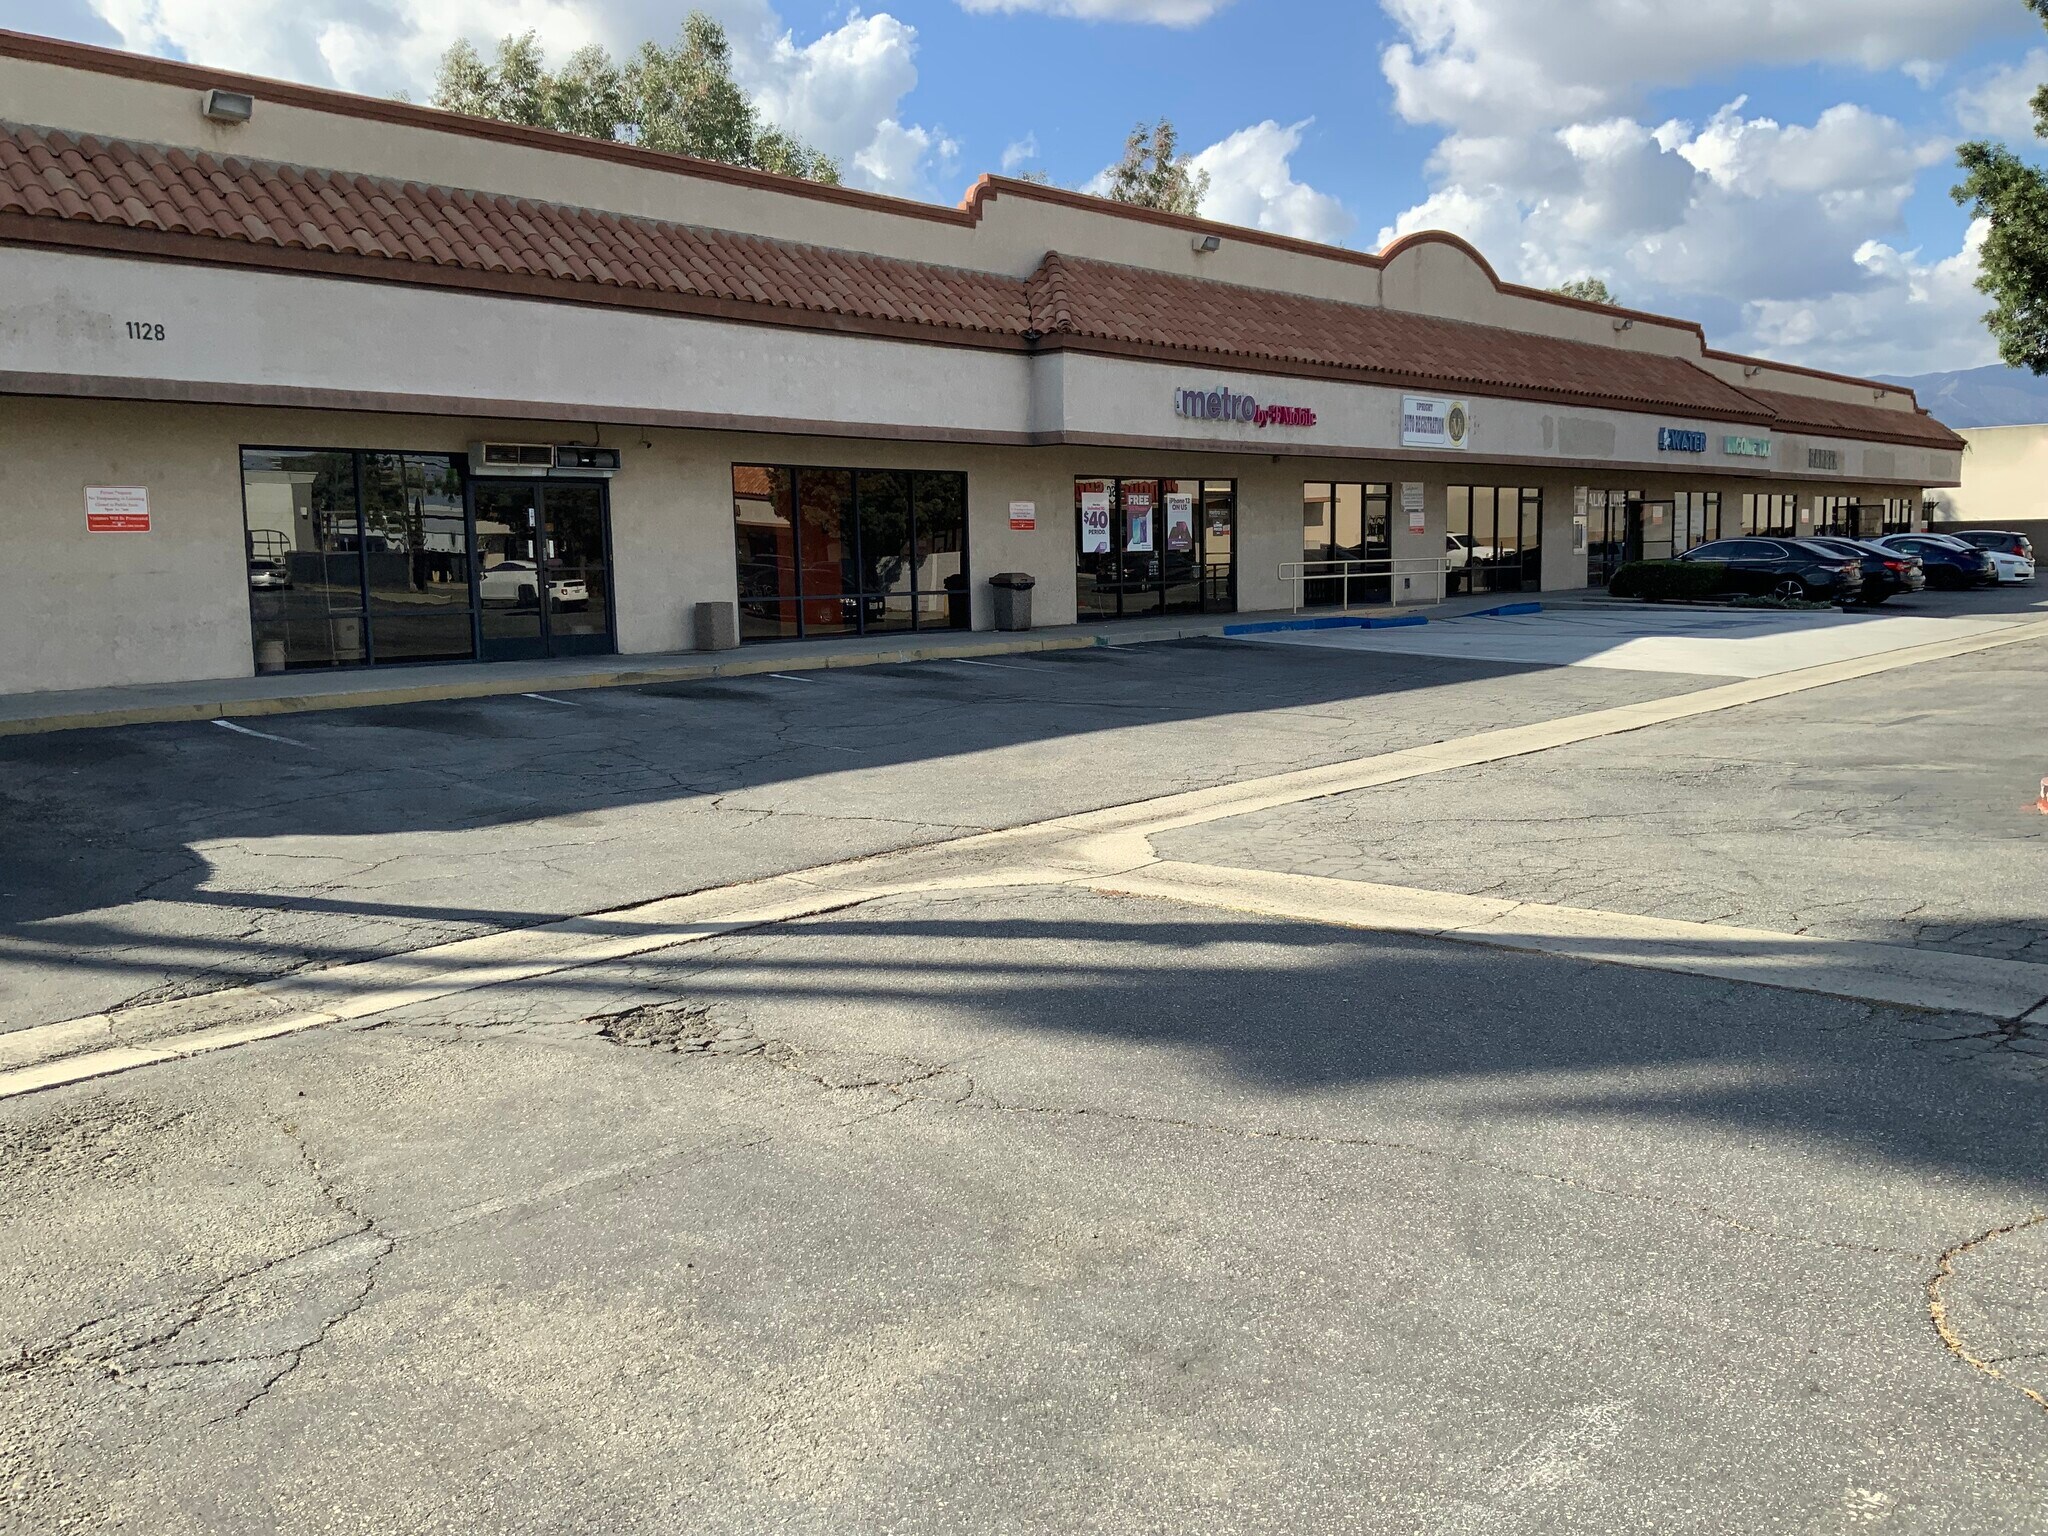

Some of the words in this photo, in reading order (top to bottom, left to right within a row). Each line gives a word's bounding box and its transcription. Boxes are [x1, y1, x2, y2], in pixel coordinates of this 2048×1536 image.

[126, 321, 166, 341] 1128
[1182, 386, 1256, 422] metro
[1671, 429, 1707, 452] WATER
[1127, 494, 1150, 505] FREE
[1083, 510, 1108, 529] $40
